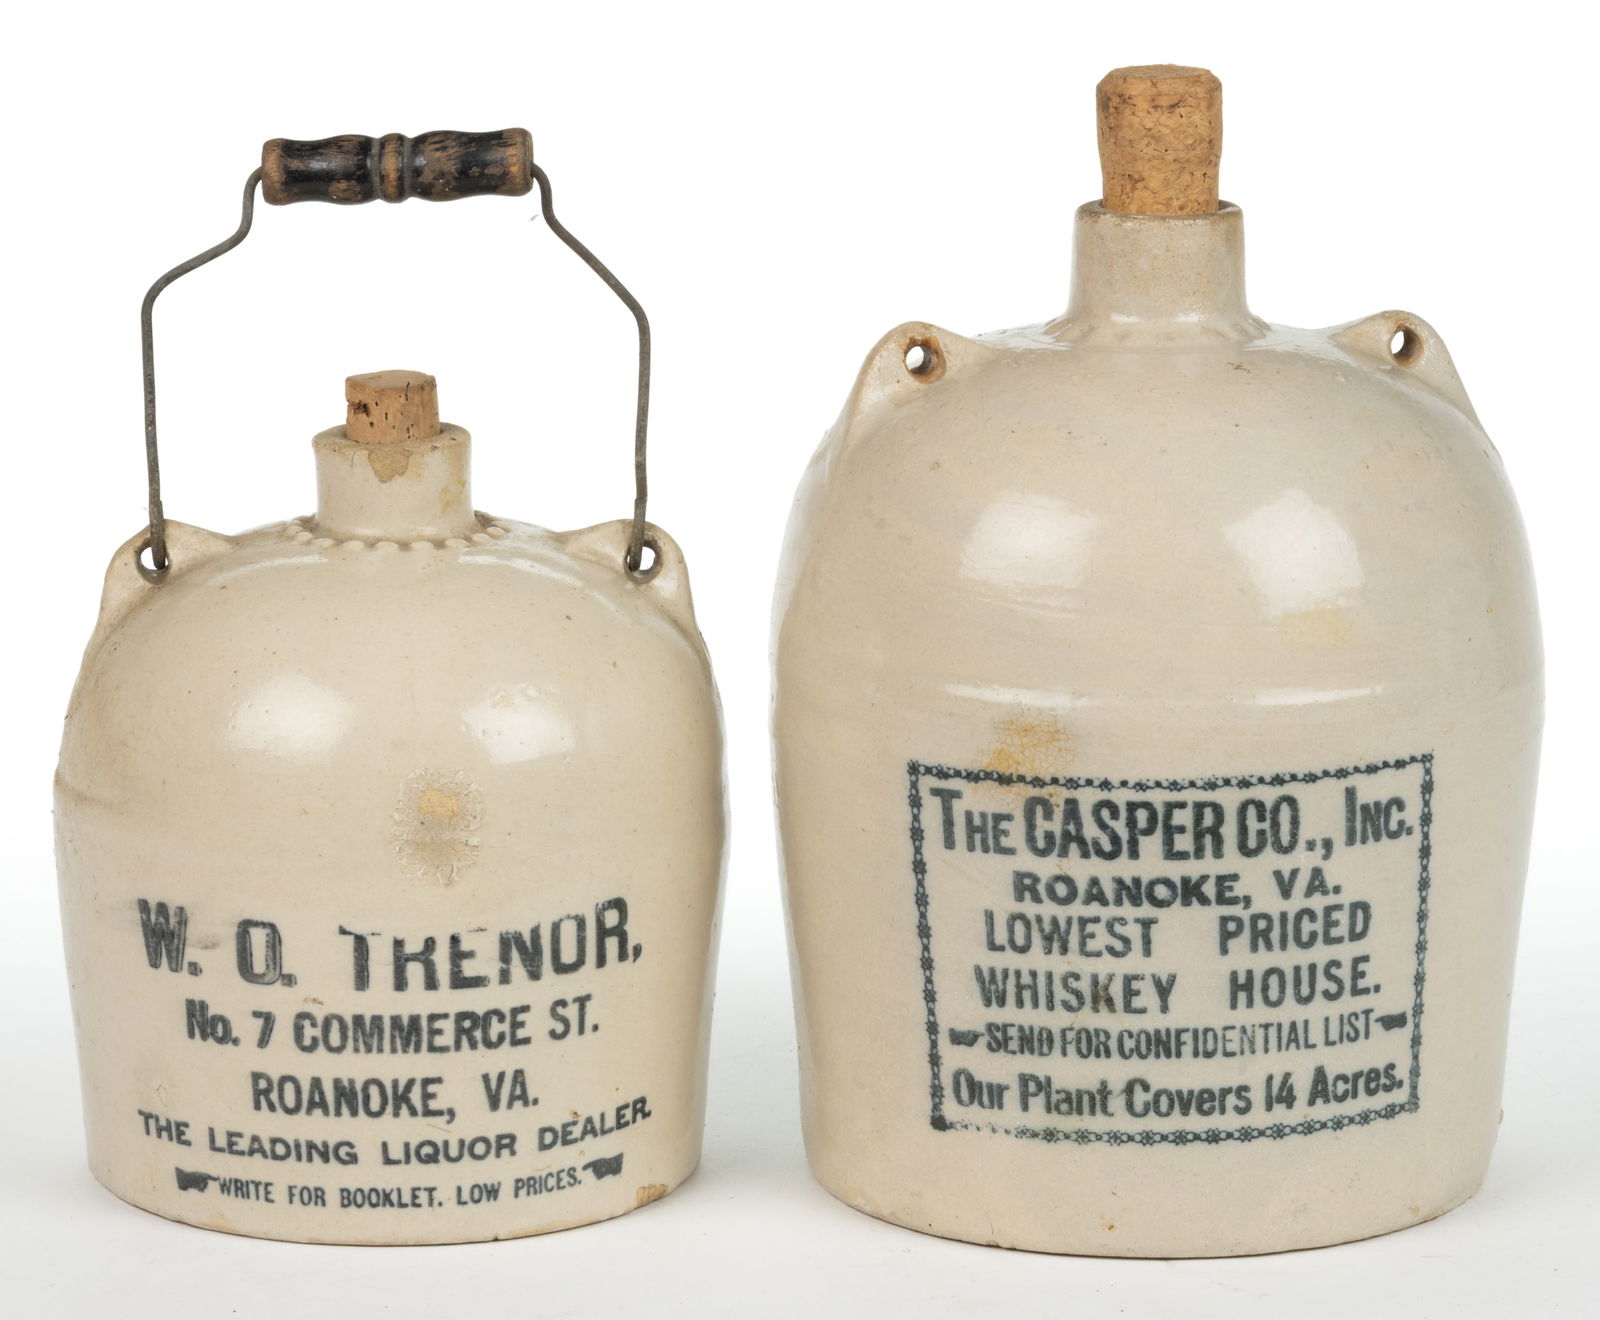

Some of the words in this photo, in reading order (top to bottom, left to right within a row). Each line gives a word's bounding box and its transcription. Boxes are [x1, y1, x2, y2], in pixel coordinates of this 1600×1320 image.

[1023, 798, 1225, 860] CASPER
[1012, 870, 1252, 910] ROANOKE,
[1273, 867, 1341, 900] VA.
[138, 898, 203, 976] W.
[236, 919, 297, 987] O.
[984, 909, 1158, 957] LOWEST
[1218, 900, 1372, 956] PRICED
[974, 964, 1177, 1014] WHISKEY
[1229, 955, 1381, 1010] HOUSE.
[186, 998, 239, 1046] No.
[251, 1010, 275, 1049] 7
[293, 1005, 532, 1054] COMMERCE
[549, 994, 600, 1040] ST.
[985, 1021, 1054, 1057] SEND
[1061, 1027, 1111, 1059] FOR
[1118, 1020, 1317, 1060] CONFIDENTIAL
[1324, 1009, 1375, 1047] LIST
[250, 1070, 456, 1124] ROANOKE,
[481, 1069, 539, 1112] VA.
[952, 1068, 1009, 1110] Our
[1019, 1073, 1114, 1117] Plant
[1125, 1078, 1252, 1117] Covers
[1265, 1072, 1297, 1111] 14
[1306, 1062, 1403, 1107] Acres.
[138, 1109, 191, 1146] THE
[208, 1126, 358, 1165] LEADING
[382, 1132, 517, 1165] LIQUOR
[215, 1175, 274, 1203] WRITE
[288, 1184, 326, 1207] FOR
[340, 1187, 443, 1209] BOOKLET.
[456, 1181, 501, 1206] LOW
[514, 1168, 582, 1198] PRICES.
